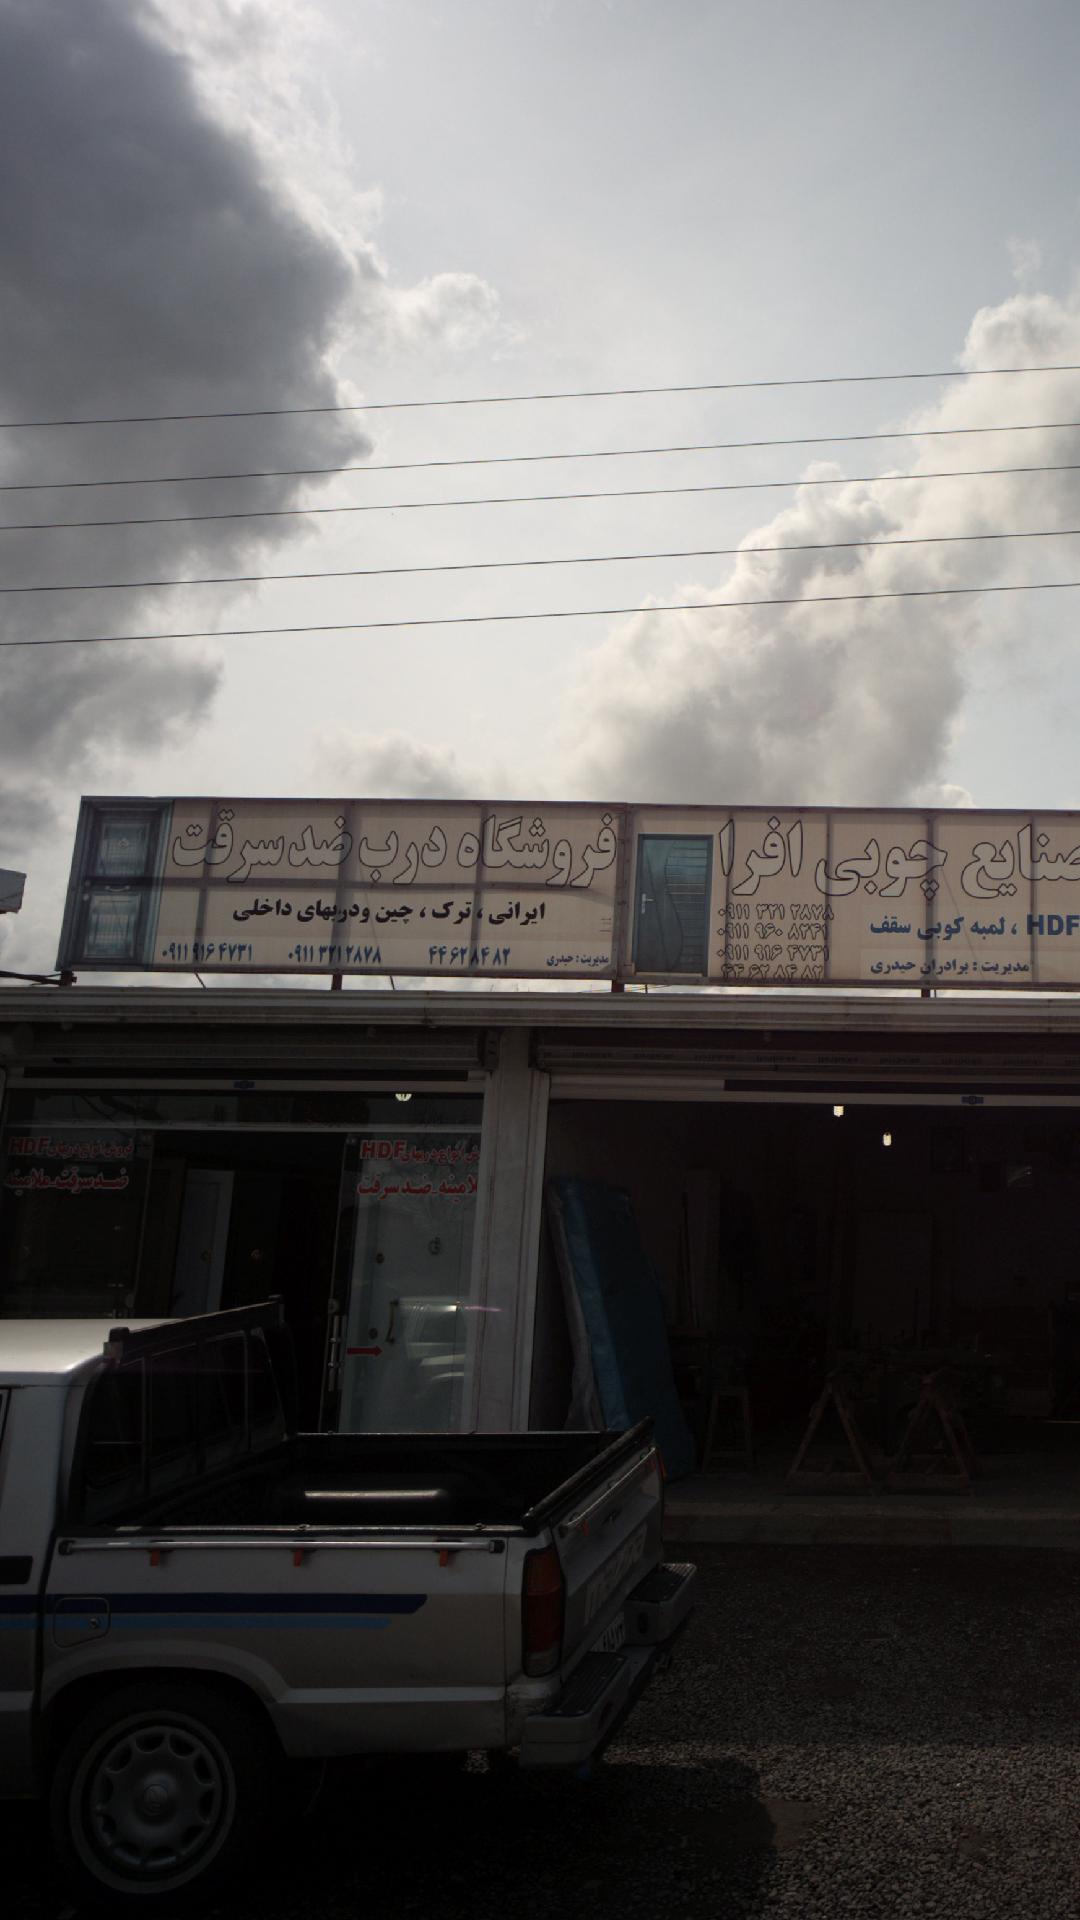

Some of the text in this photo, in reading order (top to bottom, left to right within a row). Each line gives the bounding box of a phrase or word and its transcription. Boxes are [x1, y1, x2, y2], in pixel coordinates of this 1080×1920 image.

[358, 826, 447, 884] درب
[457, 813, 616, 888] فروشگاه
[719, 816, 803, 895] افرا
[815, 838, 948, 900] چوبی
[232, 898, 293, 922] داخلی
[375, 903, 413, 925] چین
[870, 915, 912, 934] سقف
[917, 915, 965, 940] کوبی
[969, 916, 1006, 940] لمبه
[870, 960, 916, 975] حیدری
[920, 958, 969, 976] برادران
[360, 1139, 408, 1160] HDF
